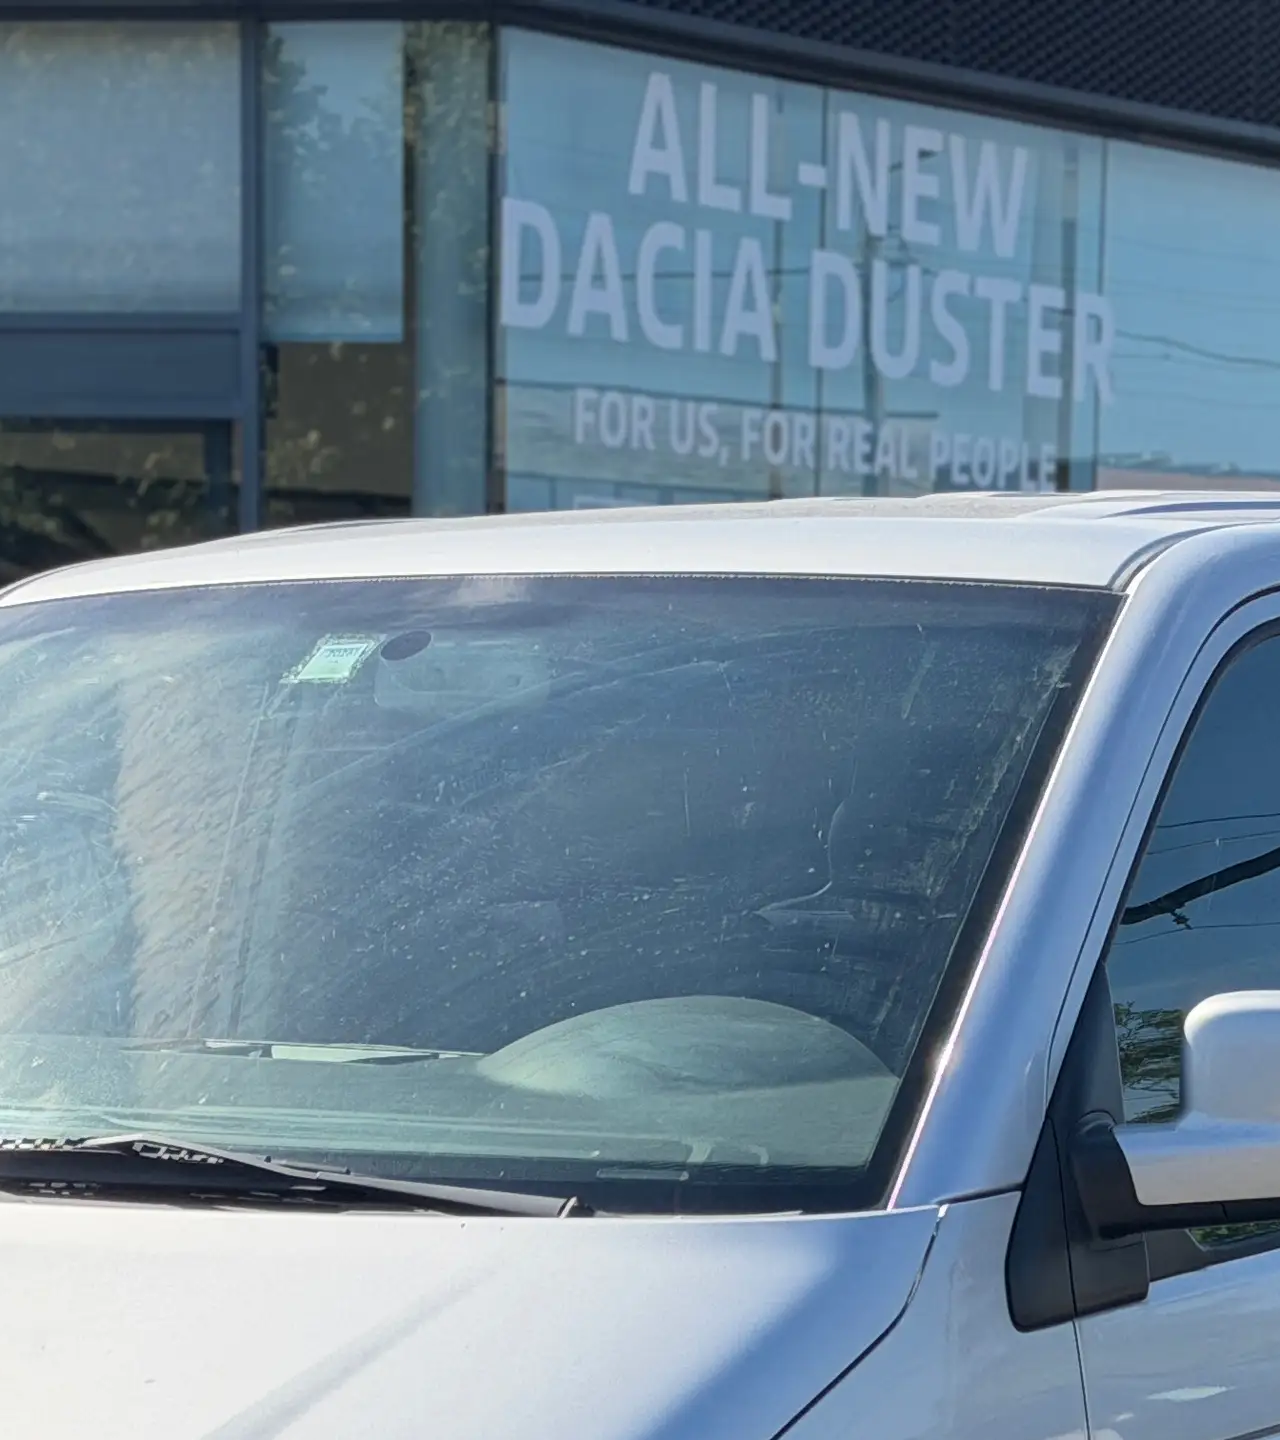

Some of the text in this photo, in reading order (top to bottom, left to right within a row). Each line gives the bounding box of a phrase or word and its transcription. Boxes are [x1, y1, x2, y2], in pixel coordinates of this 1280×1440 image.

[627, 71, 1029, 259] ALL-NEW
[499, 196, 1118, 403] DACIA DUSTER
[574, 387, 1058, 493] FOR US, FOR REAL PEOPLE
